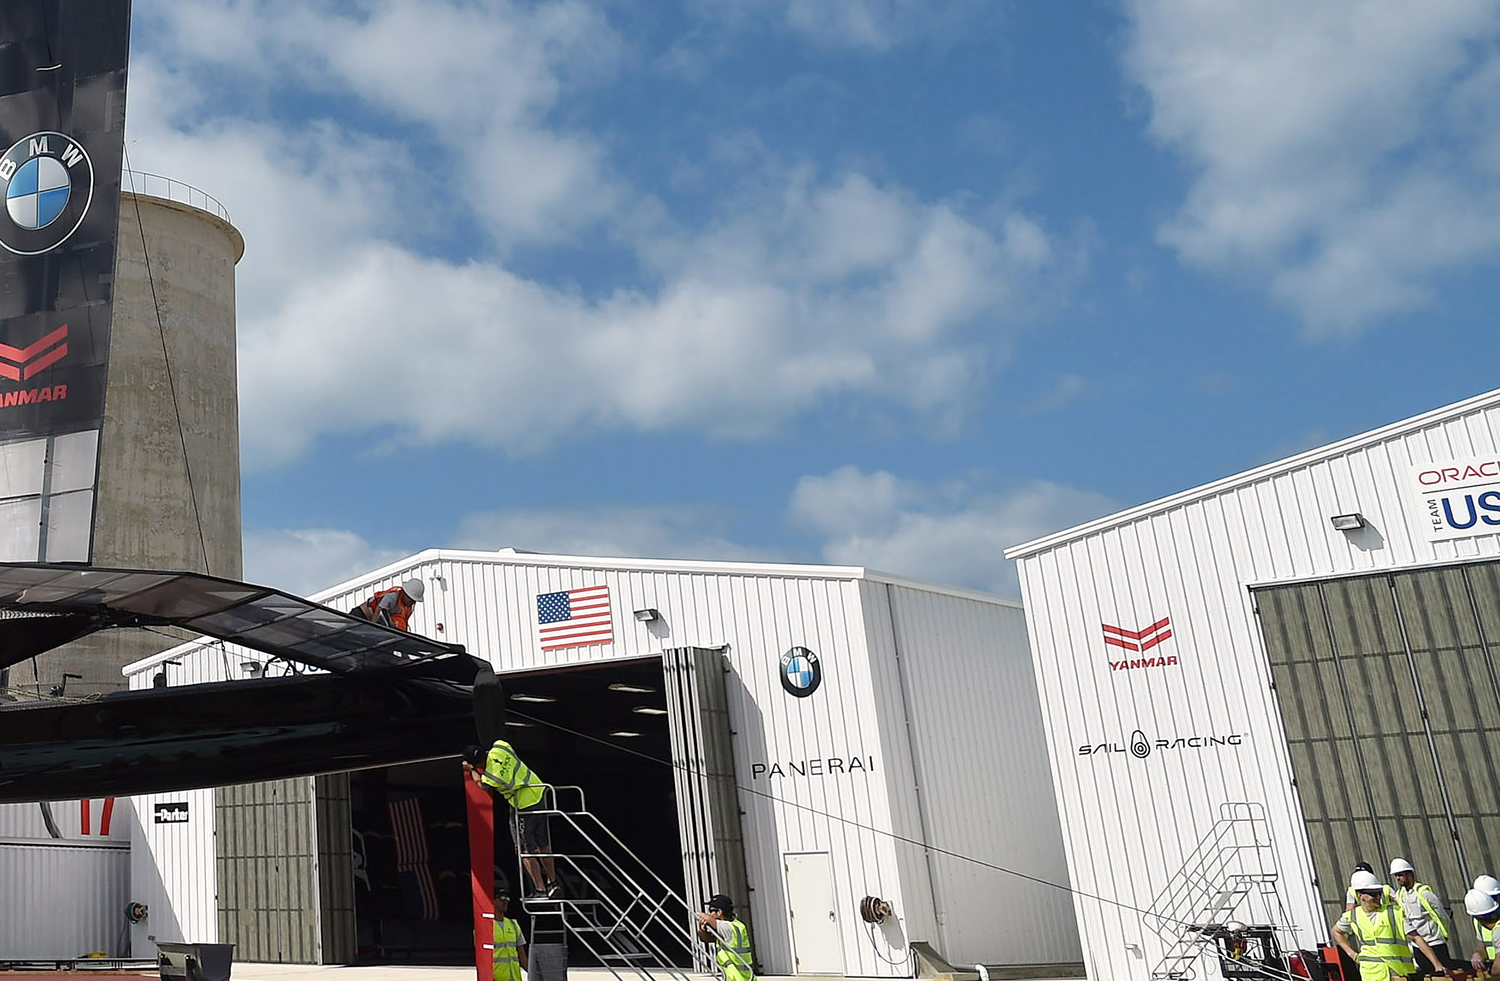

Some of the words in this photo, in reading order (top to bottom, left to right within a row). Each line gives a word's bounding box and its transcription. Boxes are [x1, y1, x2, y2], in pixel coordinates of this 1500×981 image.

[1418, 460, 1500, 485] ORAC
[1427, 498, 1443, 533] TEAM
[1441, 490, 1500, 530] US
[781, 647, 817, 666] BMW
[1109, 655, 1178, 671] YANMAR
[1079, 743, 1126, 755] SAIL
[1156, 735, 1242, 750] RACING
[751, 755, 874, 780] PANERAI
[160, 807, 188, 822] Parker
